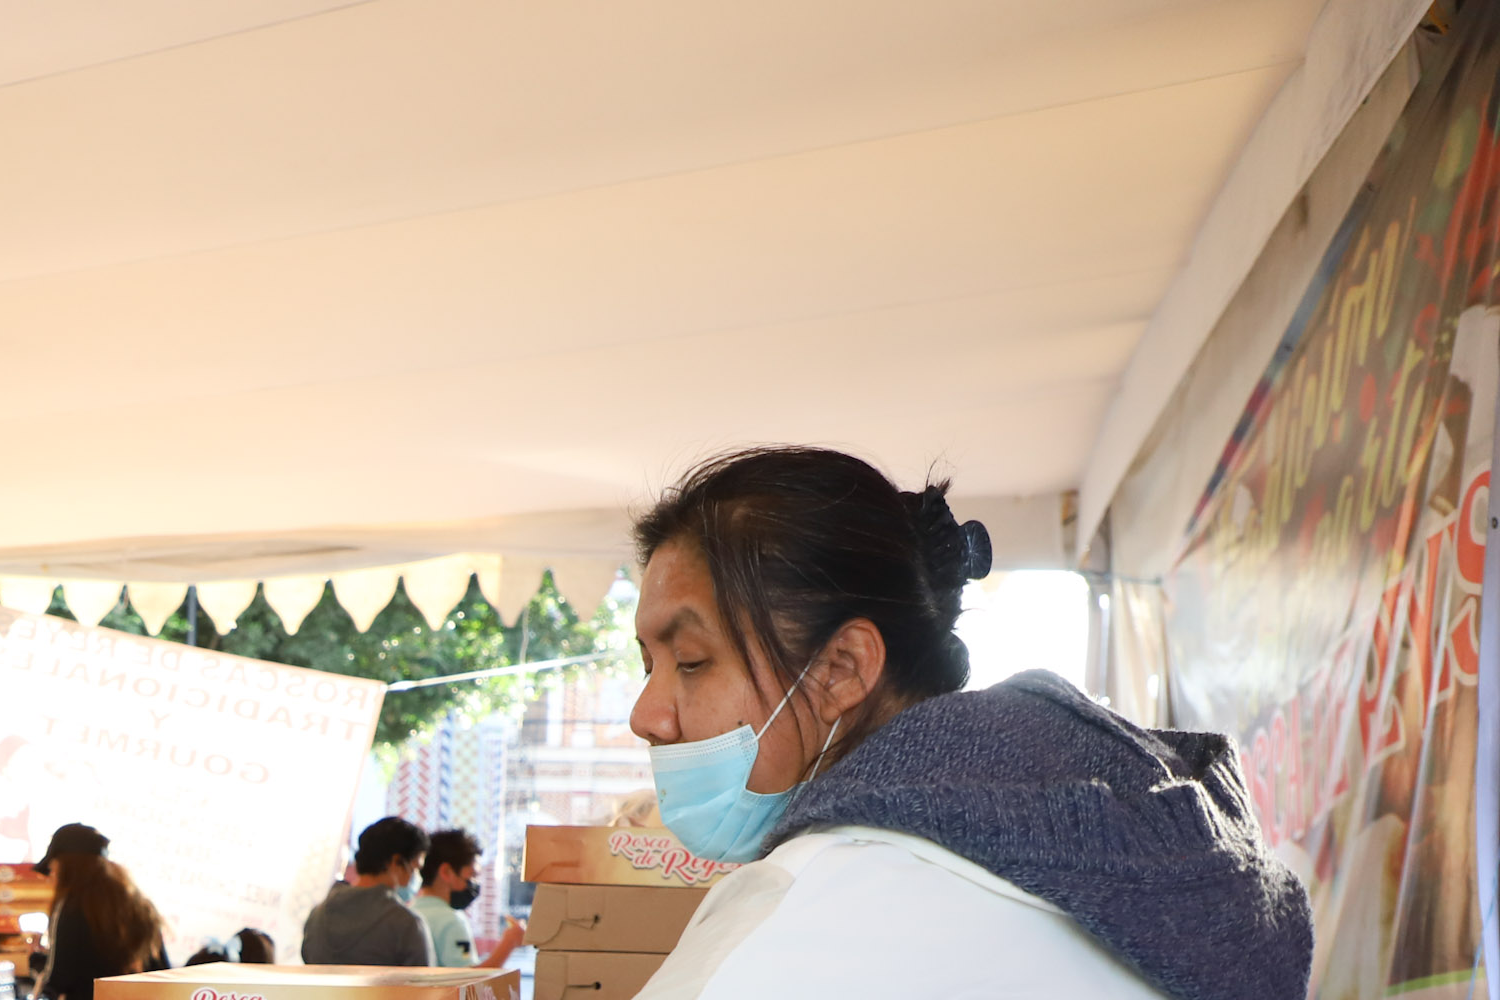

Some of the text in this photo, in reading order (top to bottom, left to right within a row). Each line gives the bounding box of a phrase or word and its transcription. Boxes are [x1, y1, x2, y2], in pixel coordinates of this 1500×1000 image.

[610, 832, 671, 856] Rosca
[635, 847, 743, 881] de Rey
